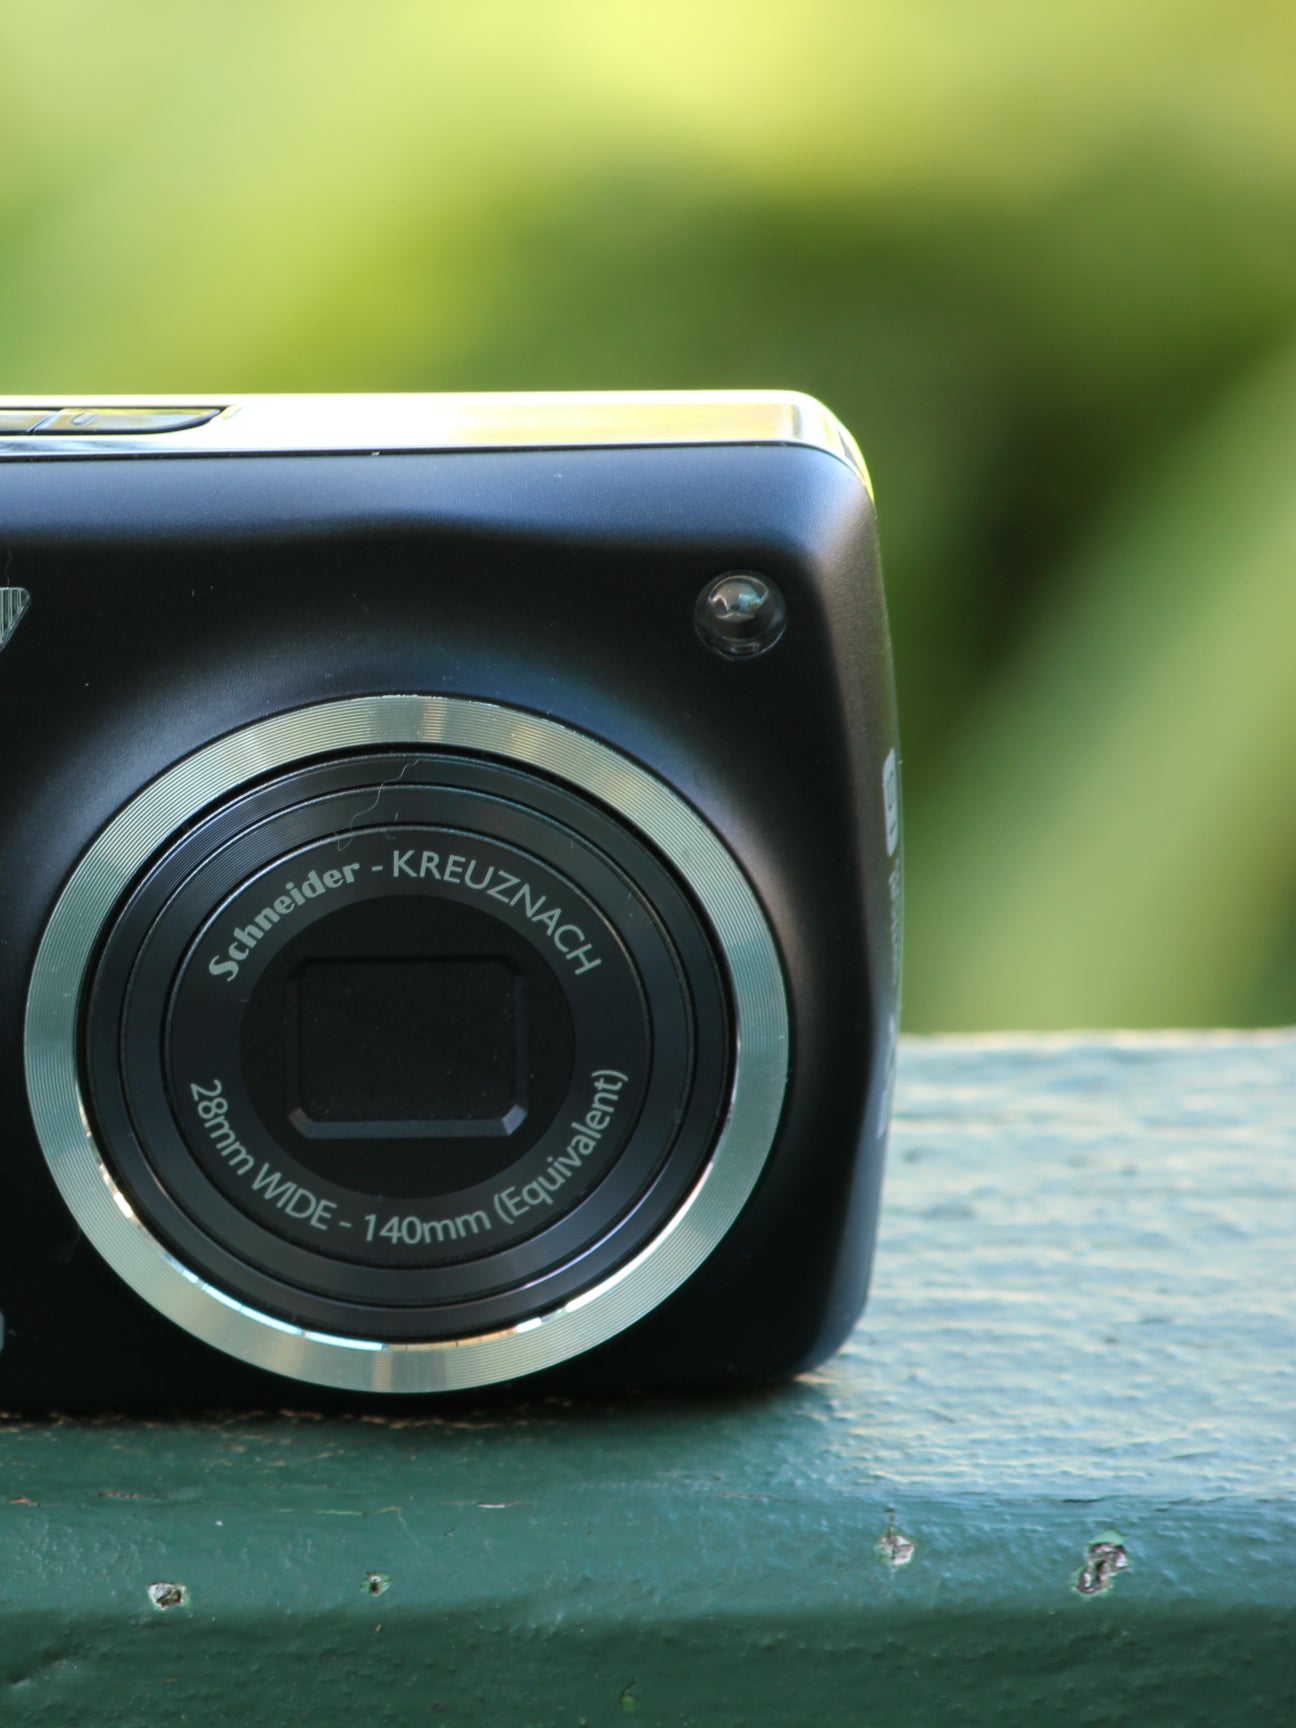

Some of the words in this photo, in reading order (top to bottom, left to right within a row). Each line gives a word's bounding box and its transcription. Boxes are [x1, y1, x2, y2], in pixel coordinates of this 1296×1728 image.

[209, 860, 361, 982] Schneider
[392, 850, 602, 976] KREUZNACH
[189, 1078, 255, 1176] 28mm
[251, 1162, 338, 1232] WIDE
[364, 1206, 494, 1246] 140mm
[492, 1068, 630, 1226] (Equivalent)
